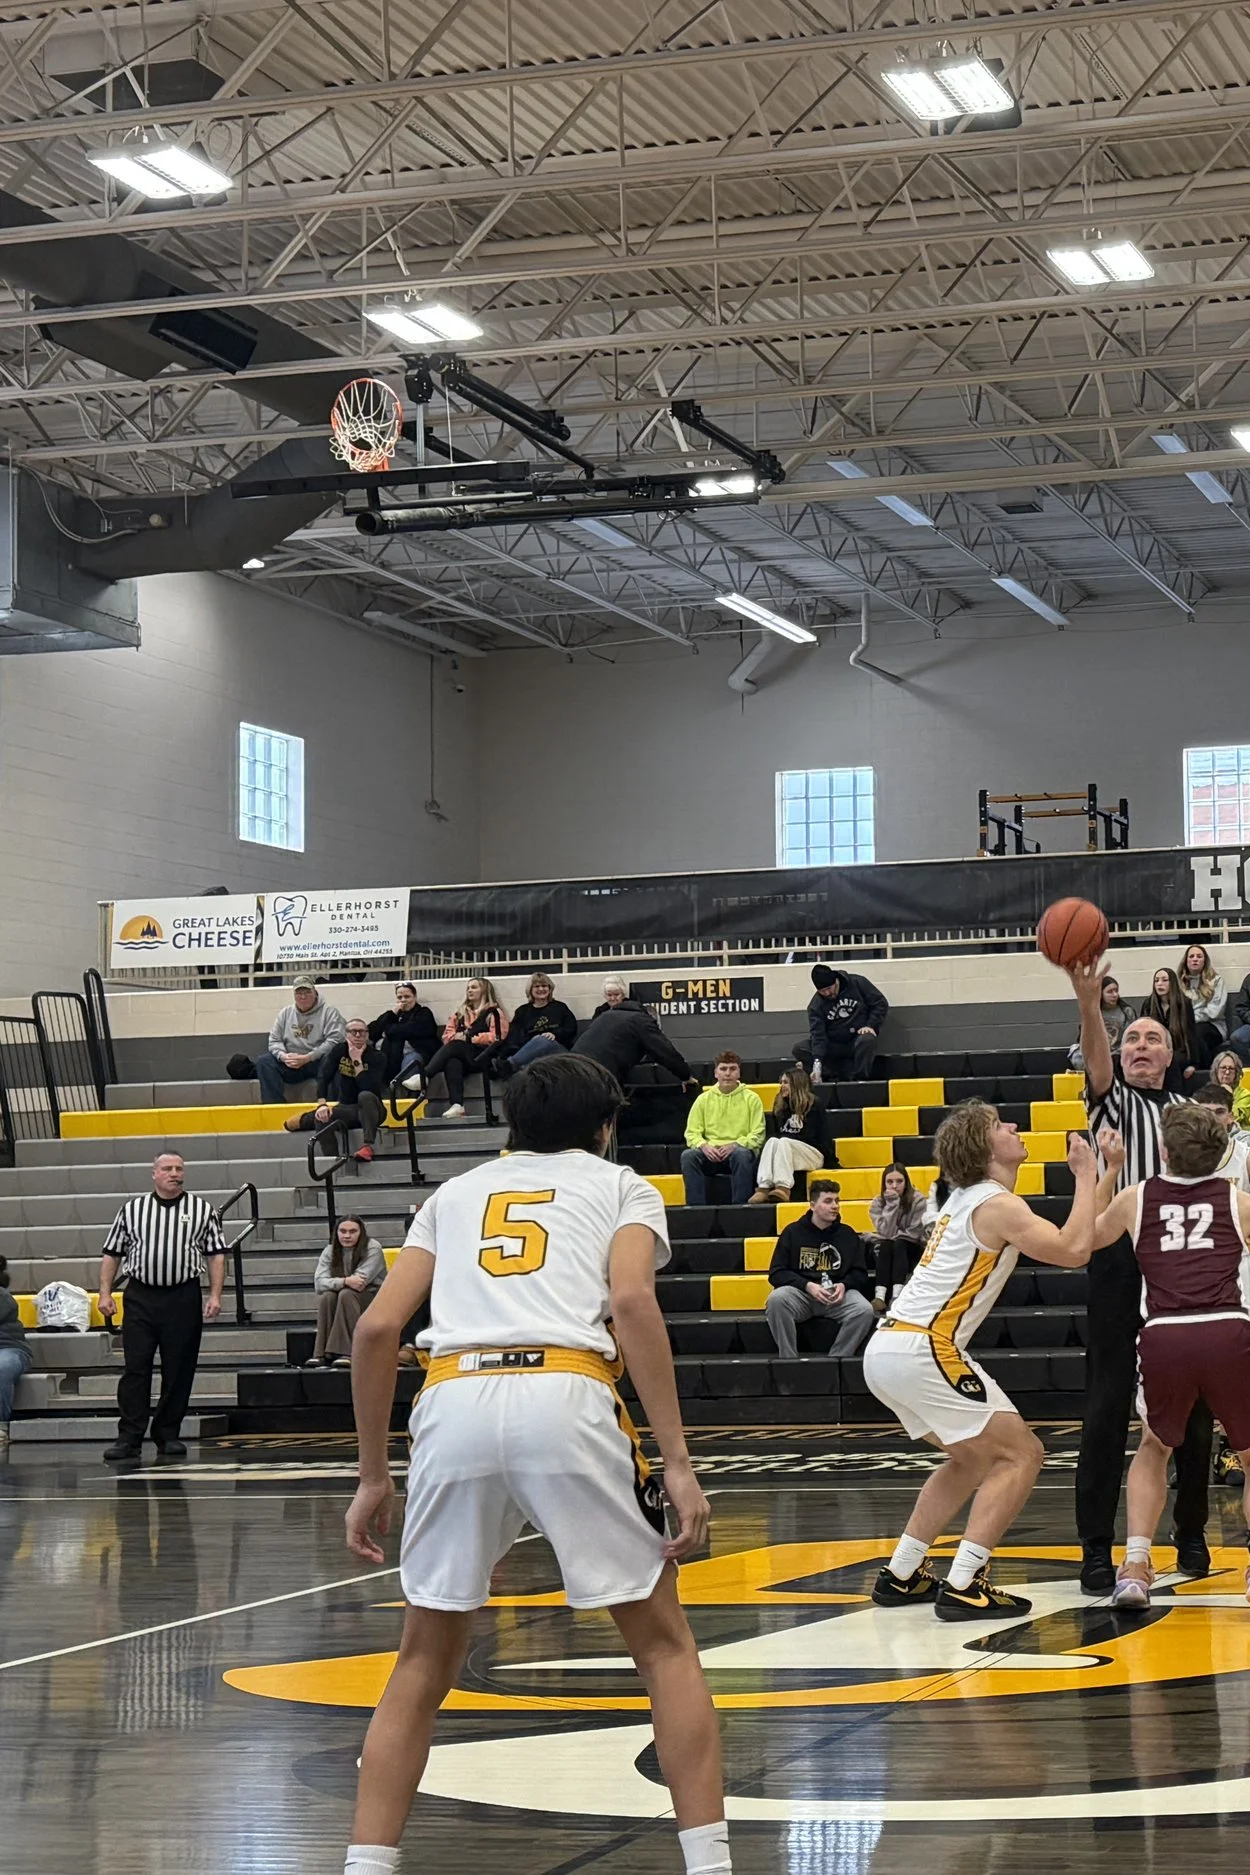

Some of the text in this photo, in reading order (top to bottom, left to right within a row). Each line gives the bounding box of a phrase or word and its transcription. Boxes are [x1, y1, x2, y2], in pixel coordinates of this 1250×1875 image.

[310, 900, 400, 912] ELLERHORST
[172, 915, 255, 929] GREAT LAKES
[330, 912, 376, 921] DENTAL
[172, 929, 254, 950] CHEESE
[279, 939, 390, 951] www.ellerhorstdental.com
[661, 979, 731, 999] G-MEN
[643, 998, 760, 1015] UDENT SECTION
[478, 1189, 556, 1278] 5
[1159, 1203, 1215, 1252] 32
